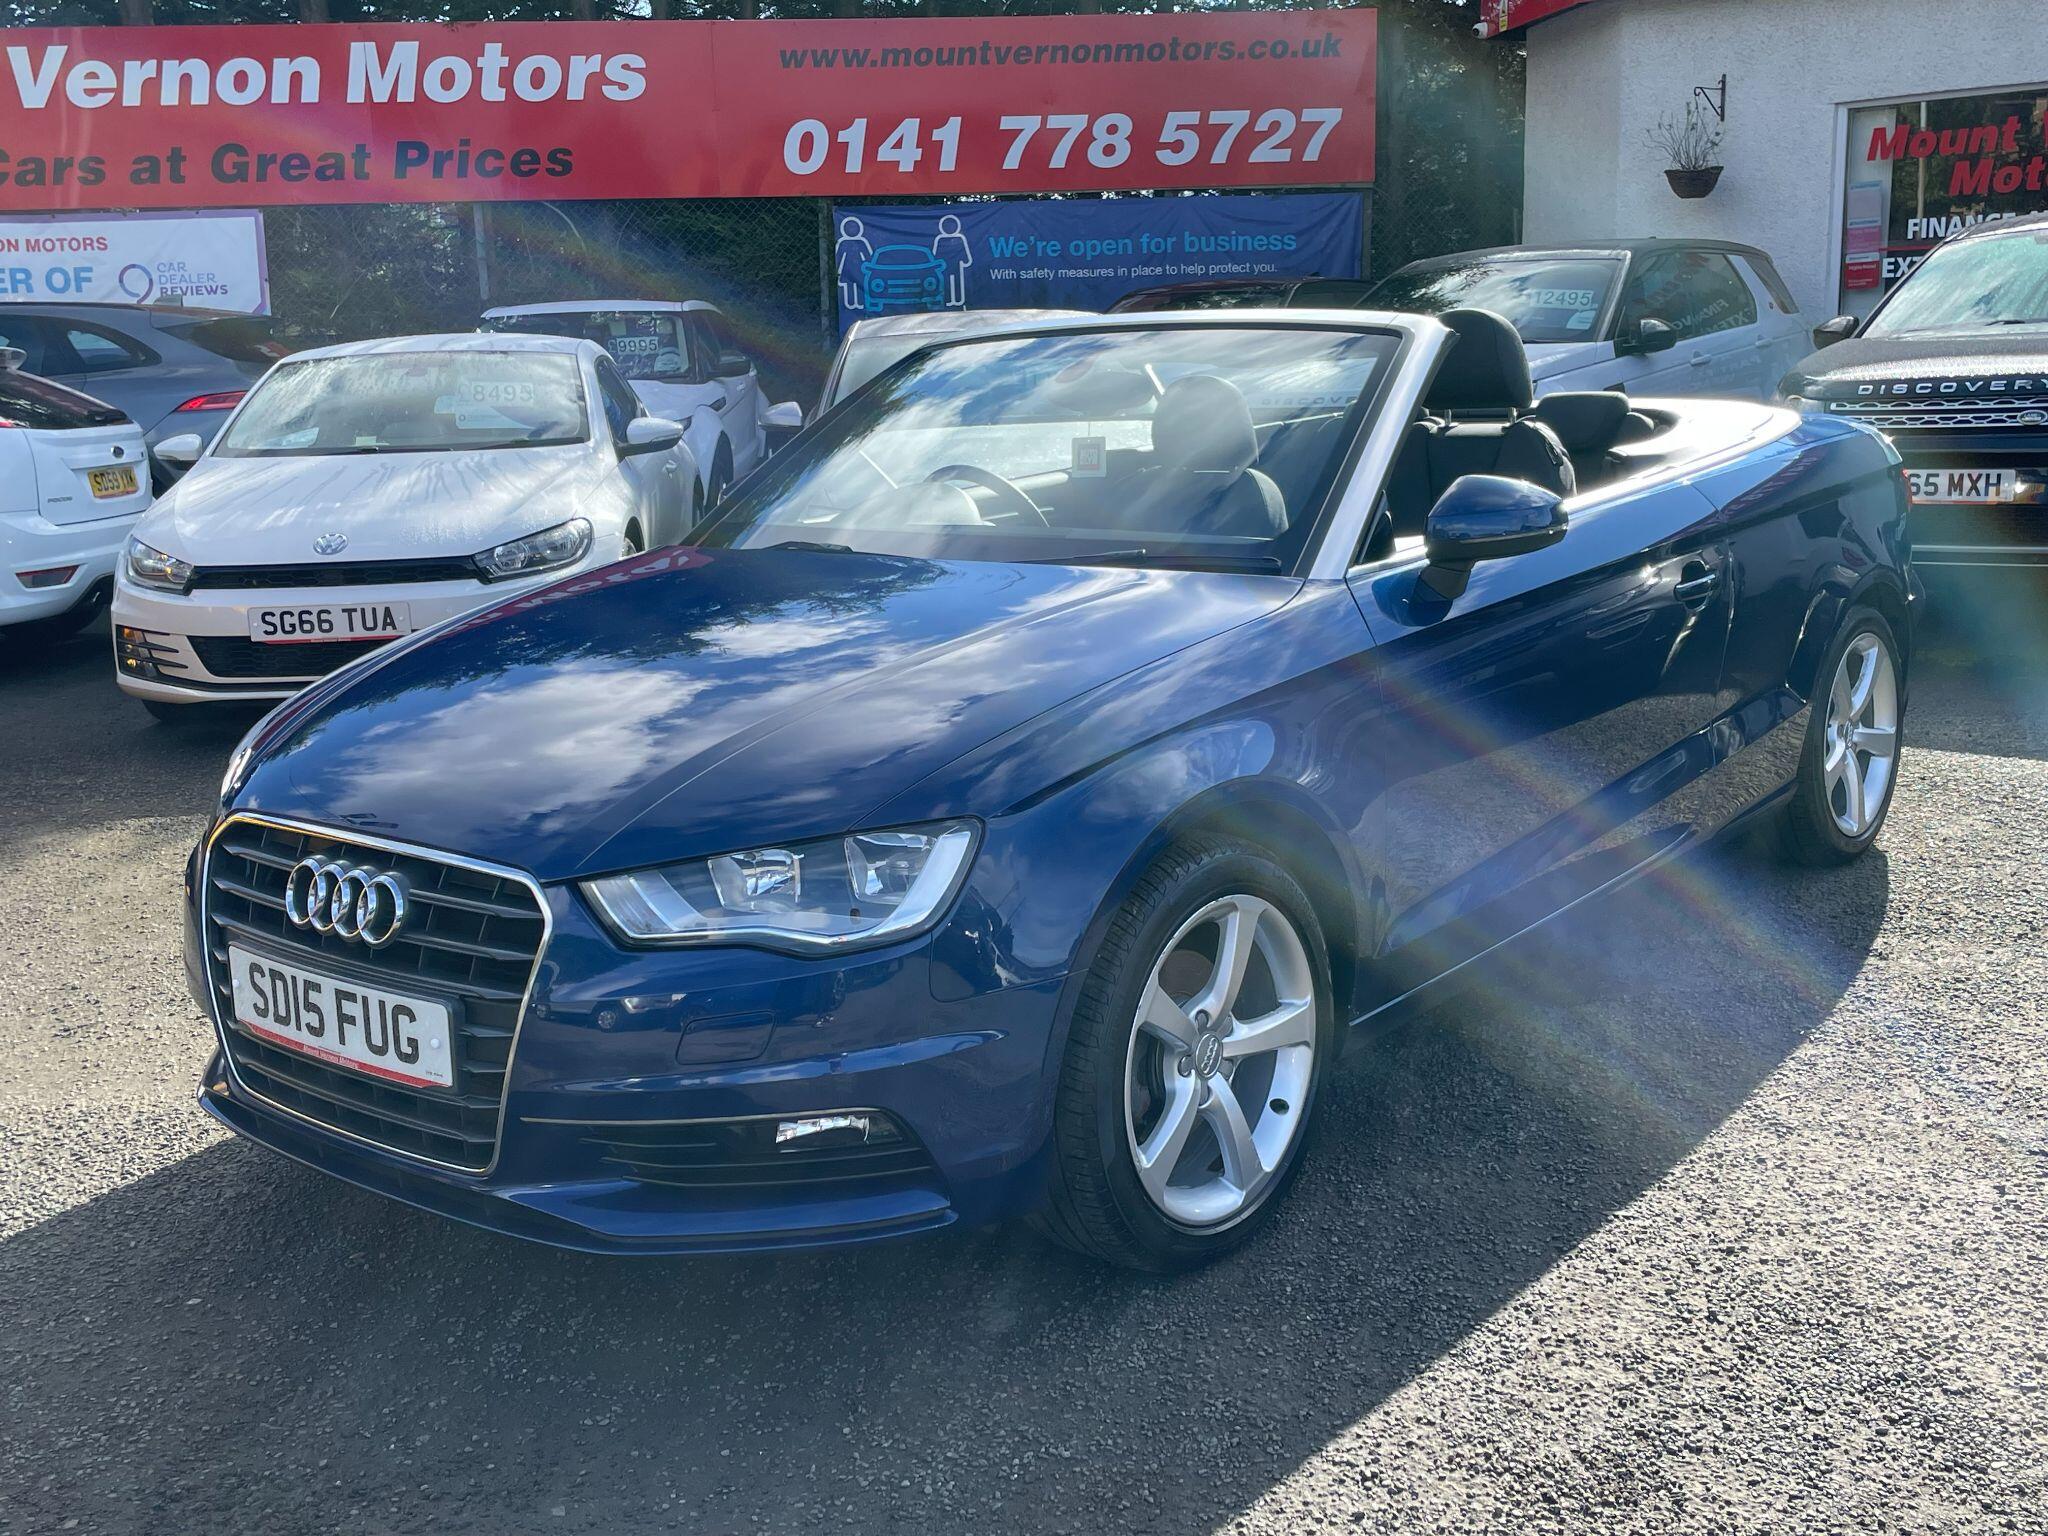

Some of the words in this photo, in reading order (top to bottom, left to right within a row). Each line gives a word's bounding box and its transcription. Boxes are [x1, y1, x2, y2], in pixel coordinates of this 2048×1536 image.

[780, 32, 1342, 69] www.mountvernonmotors.co.uk
[6, 44, 321, 108] Vernon
[346, 40, 647, 104] Motors
[783, 116, 962, 175] 0141
[999, 112, 1134, 169] 778
[1155, 107, 1344, 167] 5727
[1866, 115, 2022, 162] Mount
[129, 146, 187, 185] at
[210, 142, 371, 184] Great
[394, 138, 574, 181] Prices
[1948, 155, 2048, 197] Mot
[25, 236, 109, 252] MOTORS
[1068, 236, 1133, 260] open
[1139, 232, 1177, 254] for
[1184, 230, 1297, 253] business
[45, 266, 94, 294] OF
[157, 262, 187, 273] CAR
[158, 273, 218, 285] DEALER
[990, 267, 1017, 280] With
[1019, 267, 1055, 281] safety
[1057, 267, 1114, 278] measures
[1117, 265, 1128, 276] in
[1131, 264, 1163, 278] place
[1166, 264, 1178, 275] to
[1180, 263, 1206, 277] help
[1208, 262, 1251, 276] protect
[1253, 263, 1278, 276] you.
[160, 284, 229, 297] REVIEWS
[607, 338, 658, 353] £9995
[1908, 473, 1940, 497] 65
[1947, 473, 2002, 497] MXH
[260, 609, 334, 636] SG66
[341, 606, 398, 633] TUA
[249, 962, 326, 1038] SD15
[334, 987, 420, 1065] FUG
